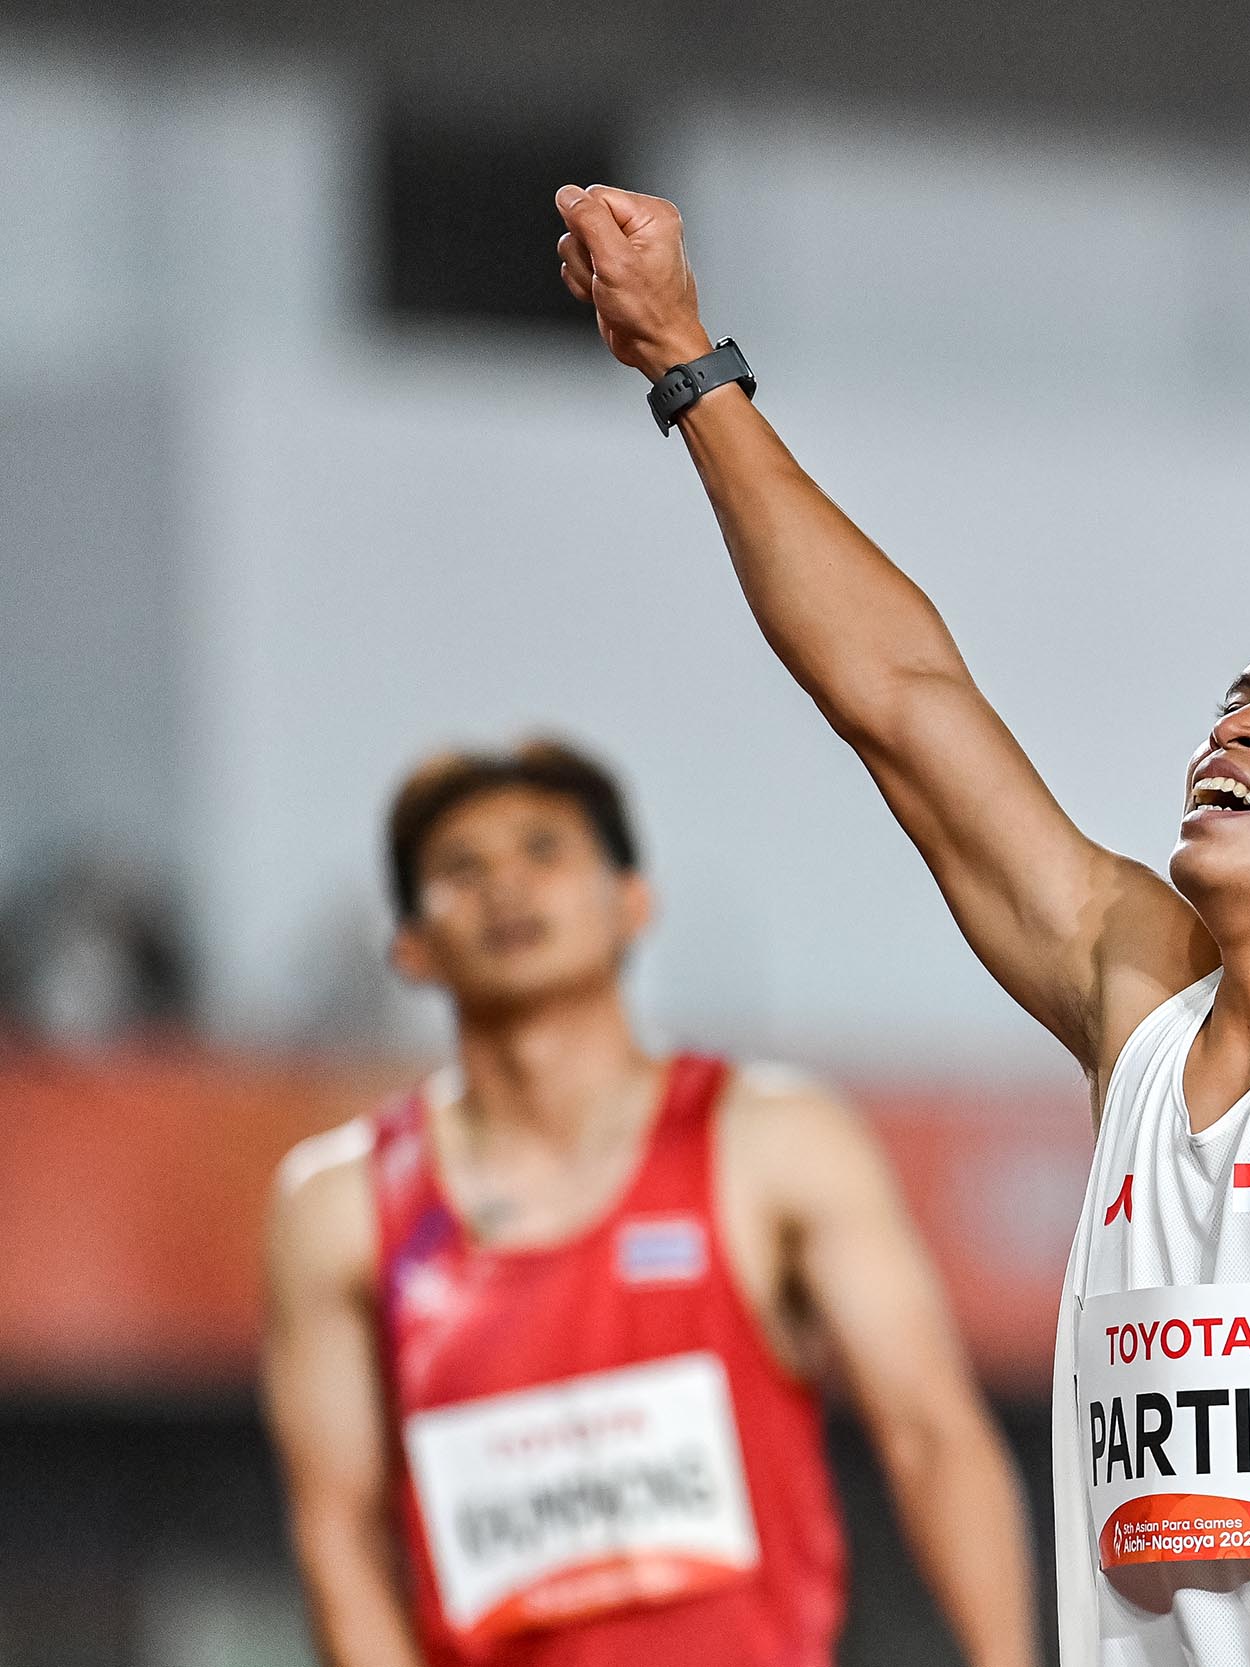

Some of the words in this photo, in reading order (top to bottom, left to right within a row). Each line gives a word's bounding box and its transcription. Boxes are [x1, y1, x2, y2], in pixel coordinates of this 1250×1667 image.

[1135, 1520, 1158, 1533] Asian
[1162, 1520, 1190, 1530] Para
[1193, 1518, 1243, 1530] Games
[1123, 1534, 1214, 1553] Aichi-Nagoya
